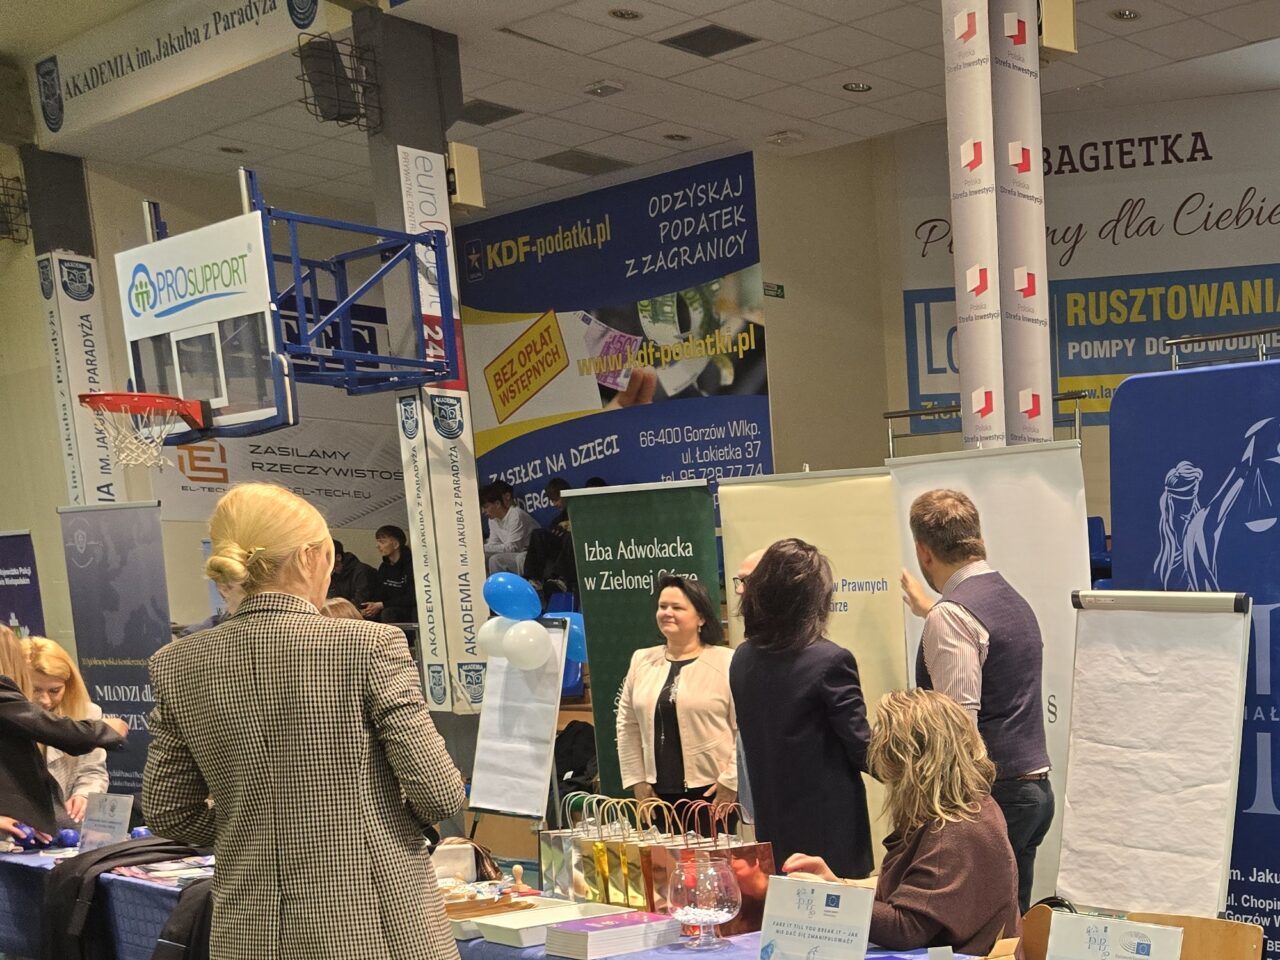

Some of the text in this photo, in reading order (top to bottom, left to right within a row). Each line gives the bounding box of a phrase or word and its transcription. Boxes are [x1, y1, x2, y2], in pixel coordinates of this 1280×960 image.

[64, 21, 212, 100] AKADEMIA z
[994, 56, 1039, 80] Strefa Inwestycji
[648, 174, 744, 218] ODZYSKAJ
[952, 183, 996, 201] Strefa Inwestycji
[1000, 185, 1044, 206] Strefa Inwestycji
[659, 204, 746, 244] PODATEK
[1098, 197, 1165, 246] dla
[486, 213, 612, 271] KDF-podatki.pl
[625, 229, 749, 279] Z ZAGRANICY
[156, 254, 249, 305] PROSUPPORT
[958, 309, 1001, 323] Strefa Inwestycji
[1005, 311, 1048, 327] Strefa Inwestycji
[493, 325, 555, 391] BEZ OPŁAT
[576, 323, 756, 377] www.kdf-podatki.pl
[1068, 337, 1137, 360] POMPY
[78, 313, 113, 474] IM. PARADYŻA
[498, 343, 561, 407] WSTĘPNYCH
[248, 444, 351, 460] ZASILAMY
[639, 419, 761, 448] 66-400 Gorzów Wlkp.
[681, 440, 762, 464] ul. Łokietka 37
[963, 433, 1005, 444] Strefa Inwestycji
[546, 435, 620, 475] NA DZIECI
[418, 507, 428, 549] JAKUBA
[448, 445, 478, 656] AKADEMIA IM. JAKUBA Z PARADYŻA
[584, 535, 694, 562] Izba Adwokacka
[584, 576, 596, 591] w
[599, 568, 655, 596] Zielonej
[841, 578, 888, 595] Prawnych
[424, 572, 438, 657] AKADEMIA
